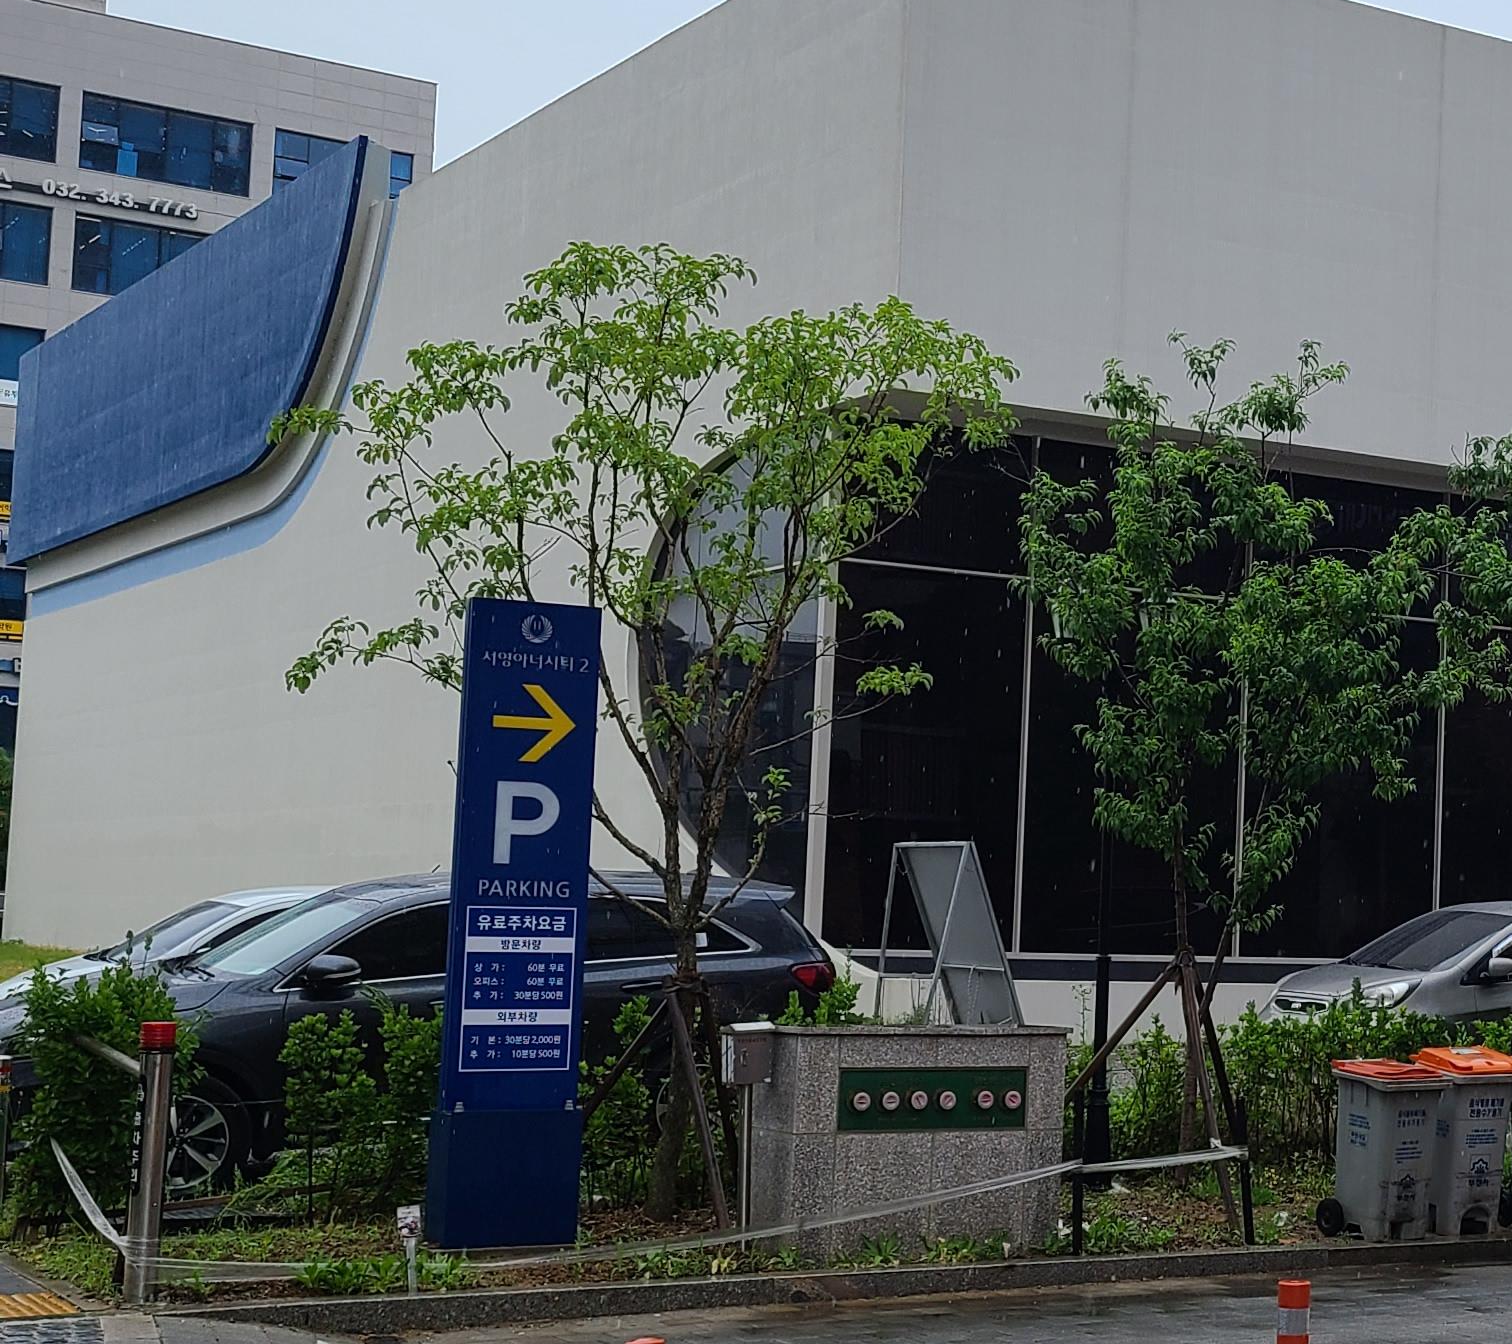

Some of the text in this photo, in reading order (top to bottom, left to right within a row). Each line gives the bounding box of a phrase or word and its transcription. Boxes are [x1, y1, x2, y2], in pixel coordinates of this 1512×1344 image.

[148, 196, 198, 219] 7773
[482, 650, 590, 673] 서영아너시티 2
[493, 780, 560, 865] P
[478, 879, 570, 898] PARKING
[477, 914, 567, 932] 유료주차요금
[500, 939, 542, 951] 방문차량
[527, 963, 545, 973] 60분
[548, 963, 565, 972] 무료
[526, 977, 545, 986] 60분
[497, 1011, 538, 1023] 외부차량
